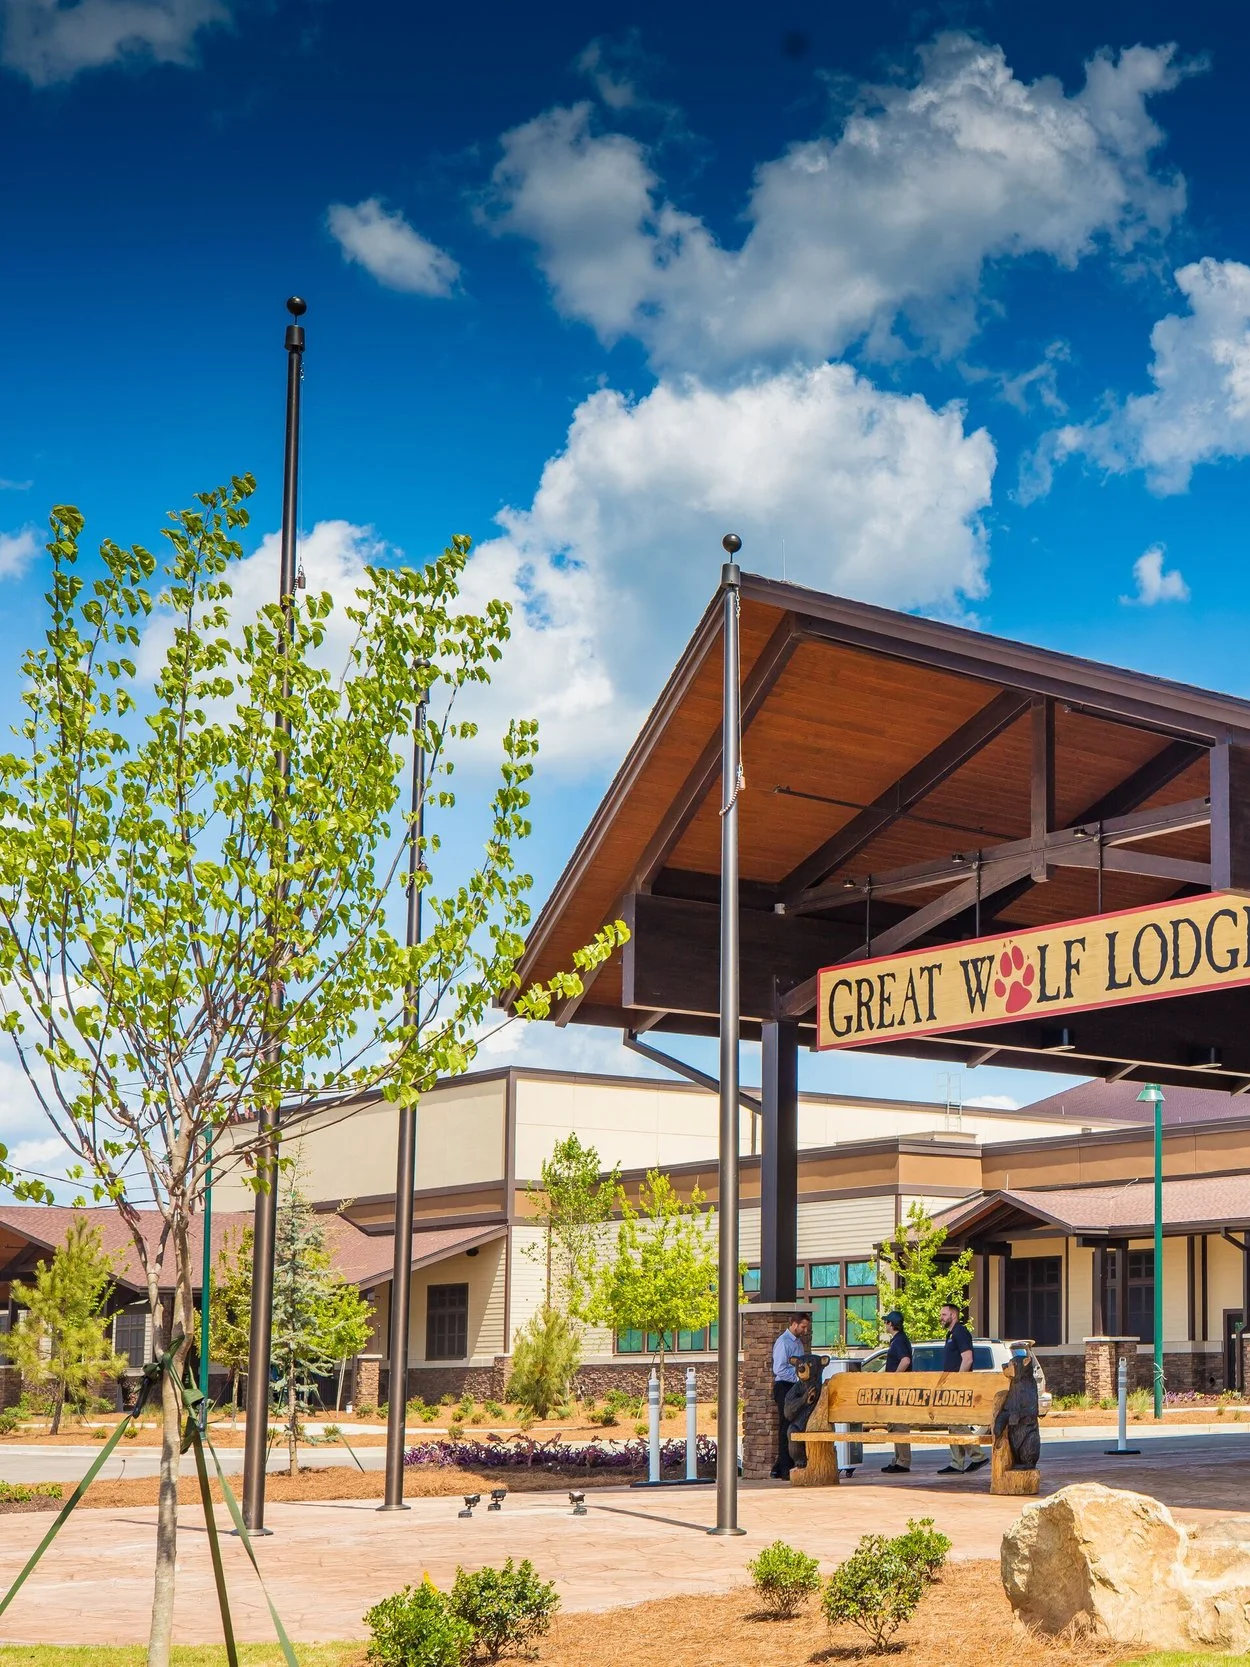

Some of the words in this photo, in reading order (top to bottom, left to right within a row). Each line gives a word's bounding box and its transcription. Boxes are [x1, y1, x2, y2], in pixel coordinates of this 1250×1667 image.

[828, 963, 942, 1037] GREAT
[858, 1389, 894, 1406] GREAT
[896, 1389, 931, 1407] WOLF
[933, 1390, 973, 1407] LODGE
